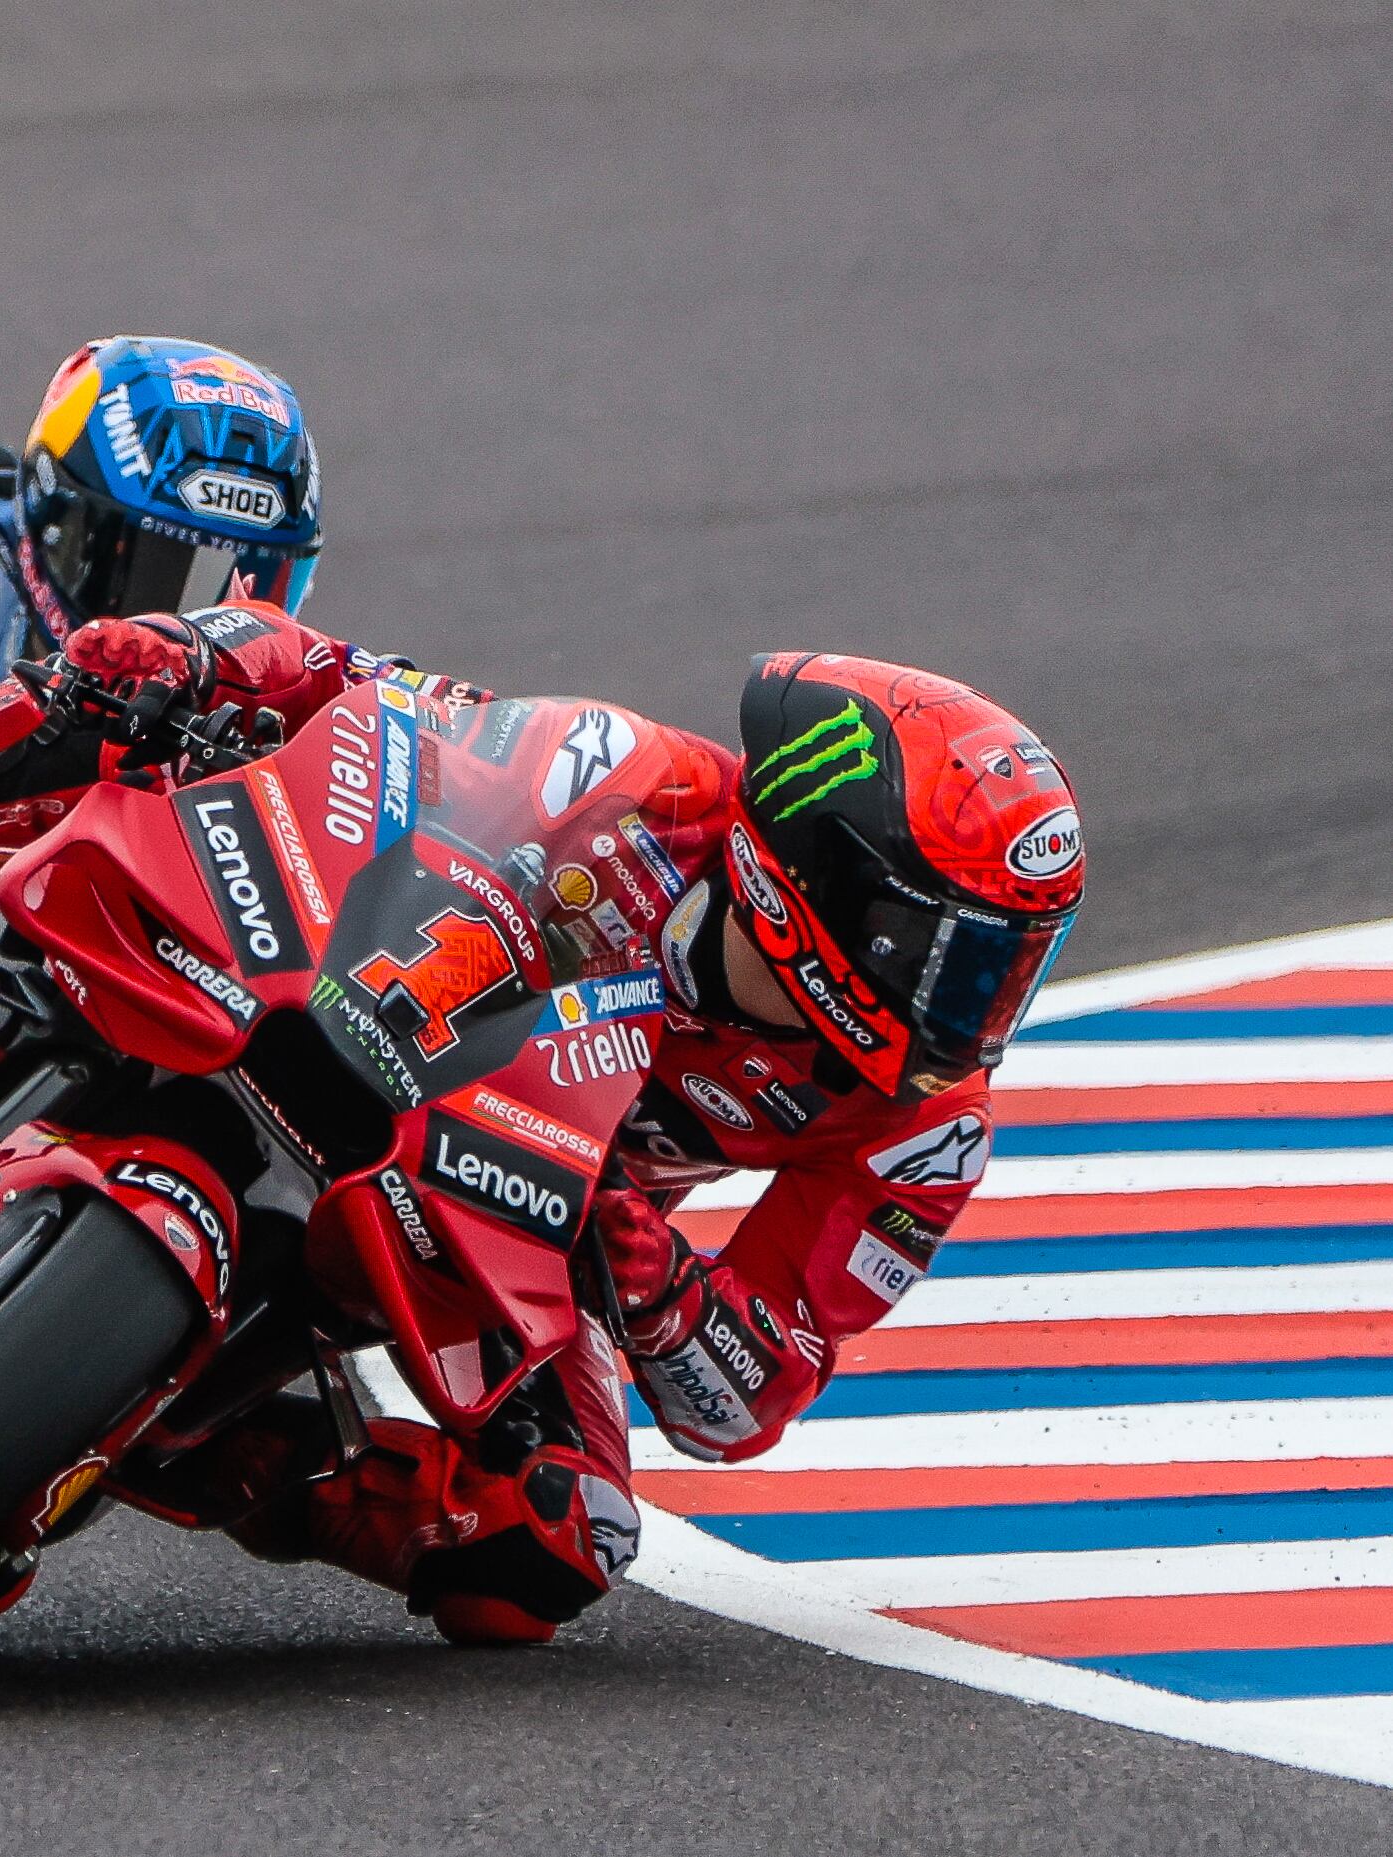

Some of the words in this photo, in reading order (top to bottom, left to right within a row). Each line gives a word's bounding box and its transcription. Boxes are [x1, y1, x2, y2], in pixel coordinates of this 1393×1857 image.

[177, 381, 236, 406] Red
[240, 386, 291, 427] Bull
[199, 481, 274, 519] SHOEI
[324, 737, 375, 845] riello
[384, 717, 411, 828] ADVANCE
[195, 799, 280, 961] Lenovo
[259, 770, 333, 925] FRECCIAROSSA
[607, 854, 657, 922] motorola
[448, 858, 536, 962] VARGROUP
[155, 934, 258, 1021] CARRERA
[348, 905, 518, 1063] 1
[597, 977, 662, 1014] ADVANCE
[797, 958, 873, 1047] Lenovo
[339, 997, 424, 1108] MONSTER
[567, 1022, 652, 1084] riello
[473, 1091, 601, 1161] FRECCIAROSSA
[770, 1081, 807, 1122] Lenovo
[379, 1169, 438, 1261] CARRERA
[436, 1132, 569, 1227] Lenovo
[116, 1164, 231, 1293] Lenovo
[704, 1305, 766, 1391] Lenovo
